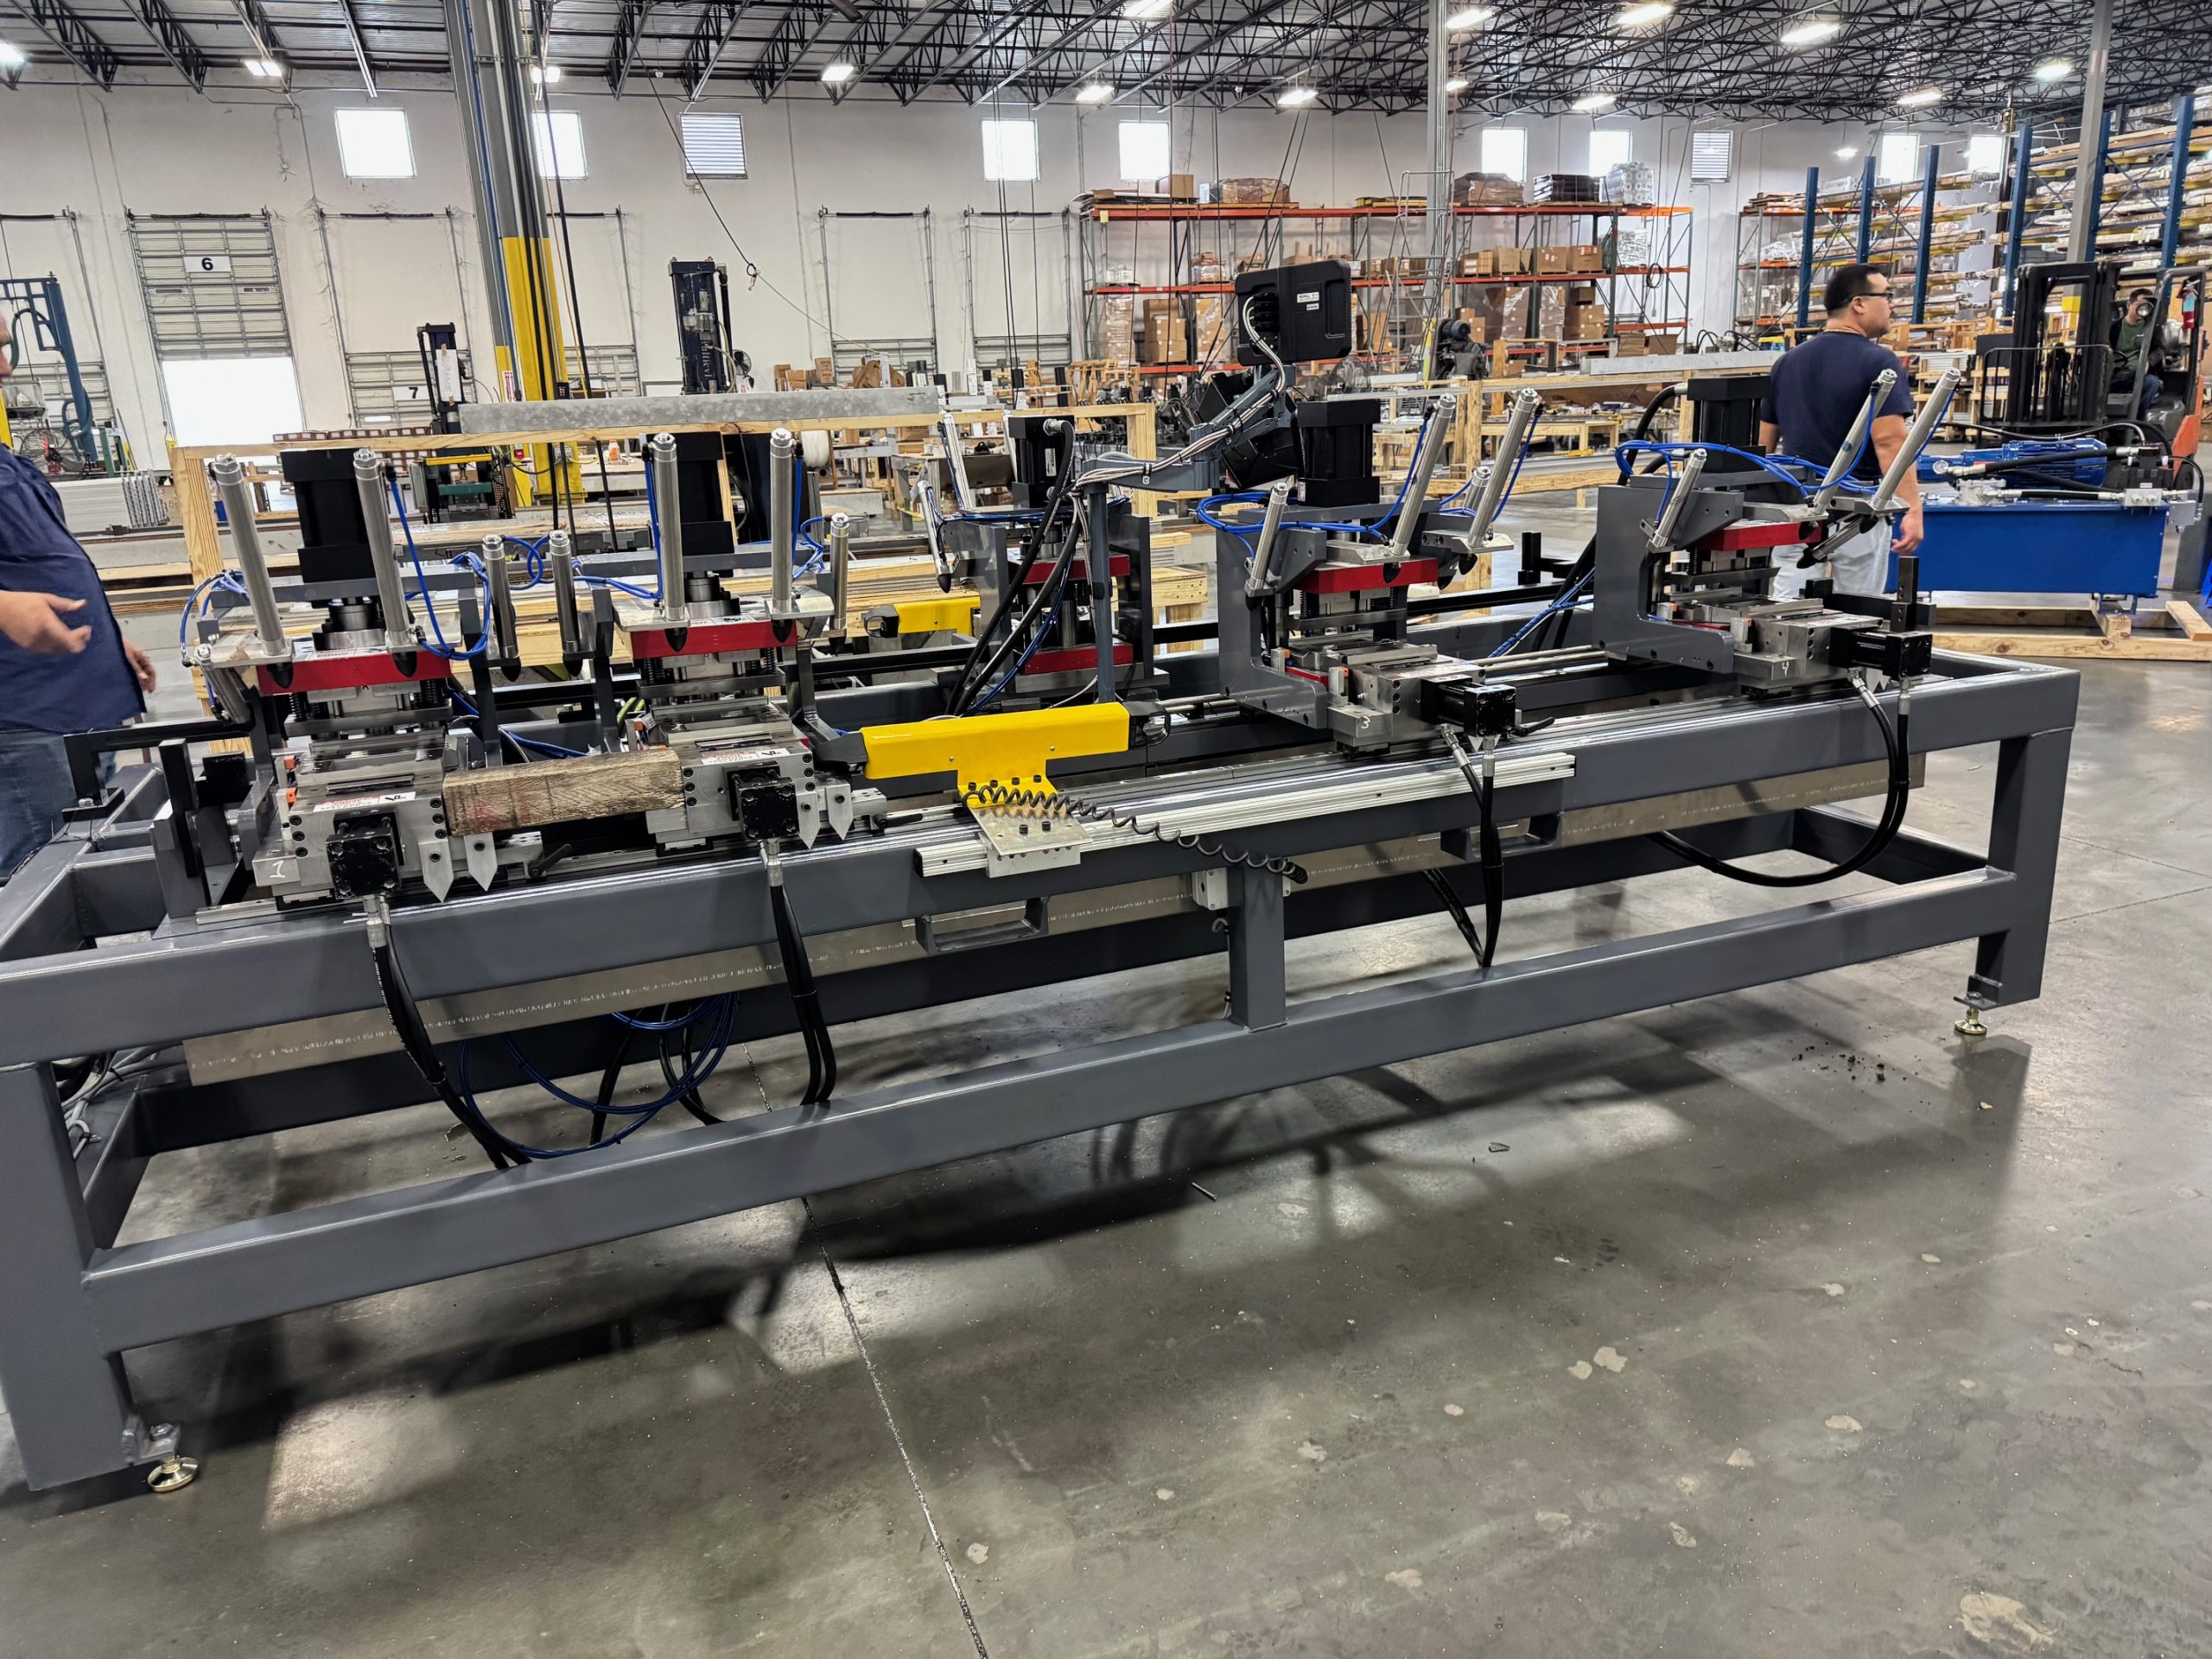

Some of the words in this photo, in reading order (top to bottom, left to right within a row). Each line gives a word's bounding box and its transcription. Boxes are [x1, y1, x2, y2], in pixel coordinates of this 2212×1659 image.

[201, 257, 213, 270] 6
[409, 386, 418, 399] 7
[1782, 661, 1789, 677] 4
[1361, 715, 1370, 729] 3
[270, 860, 286, 879] 1
